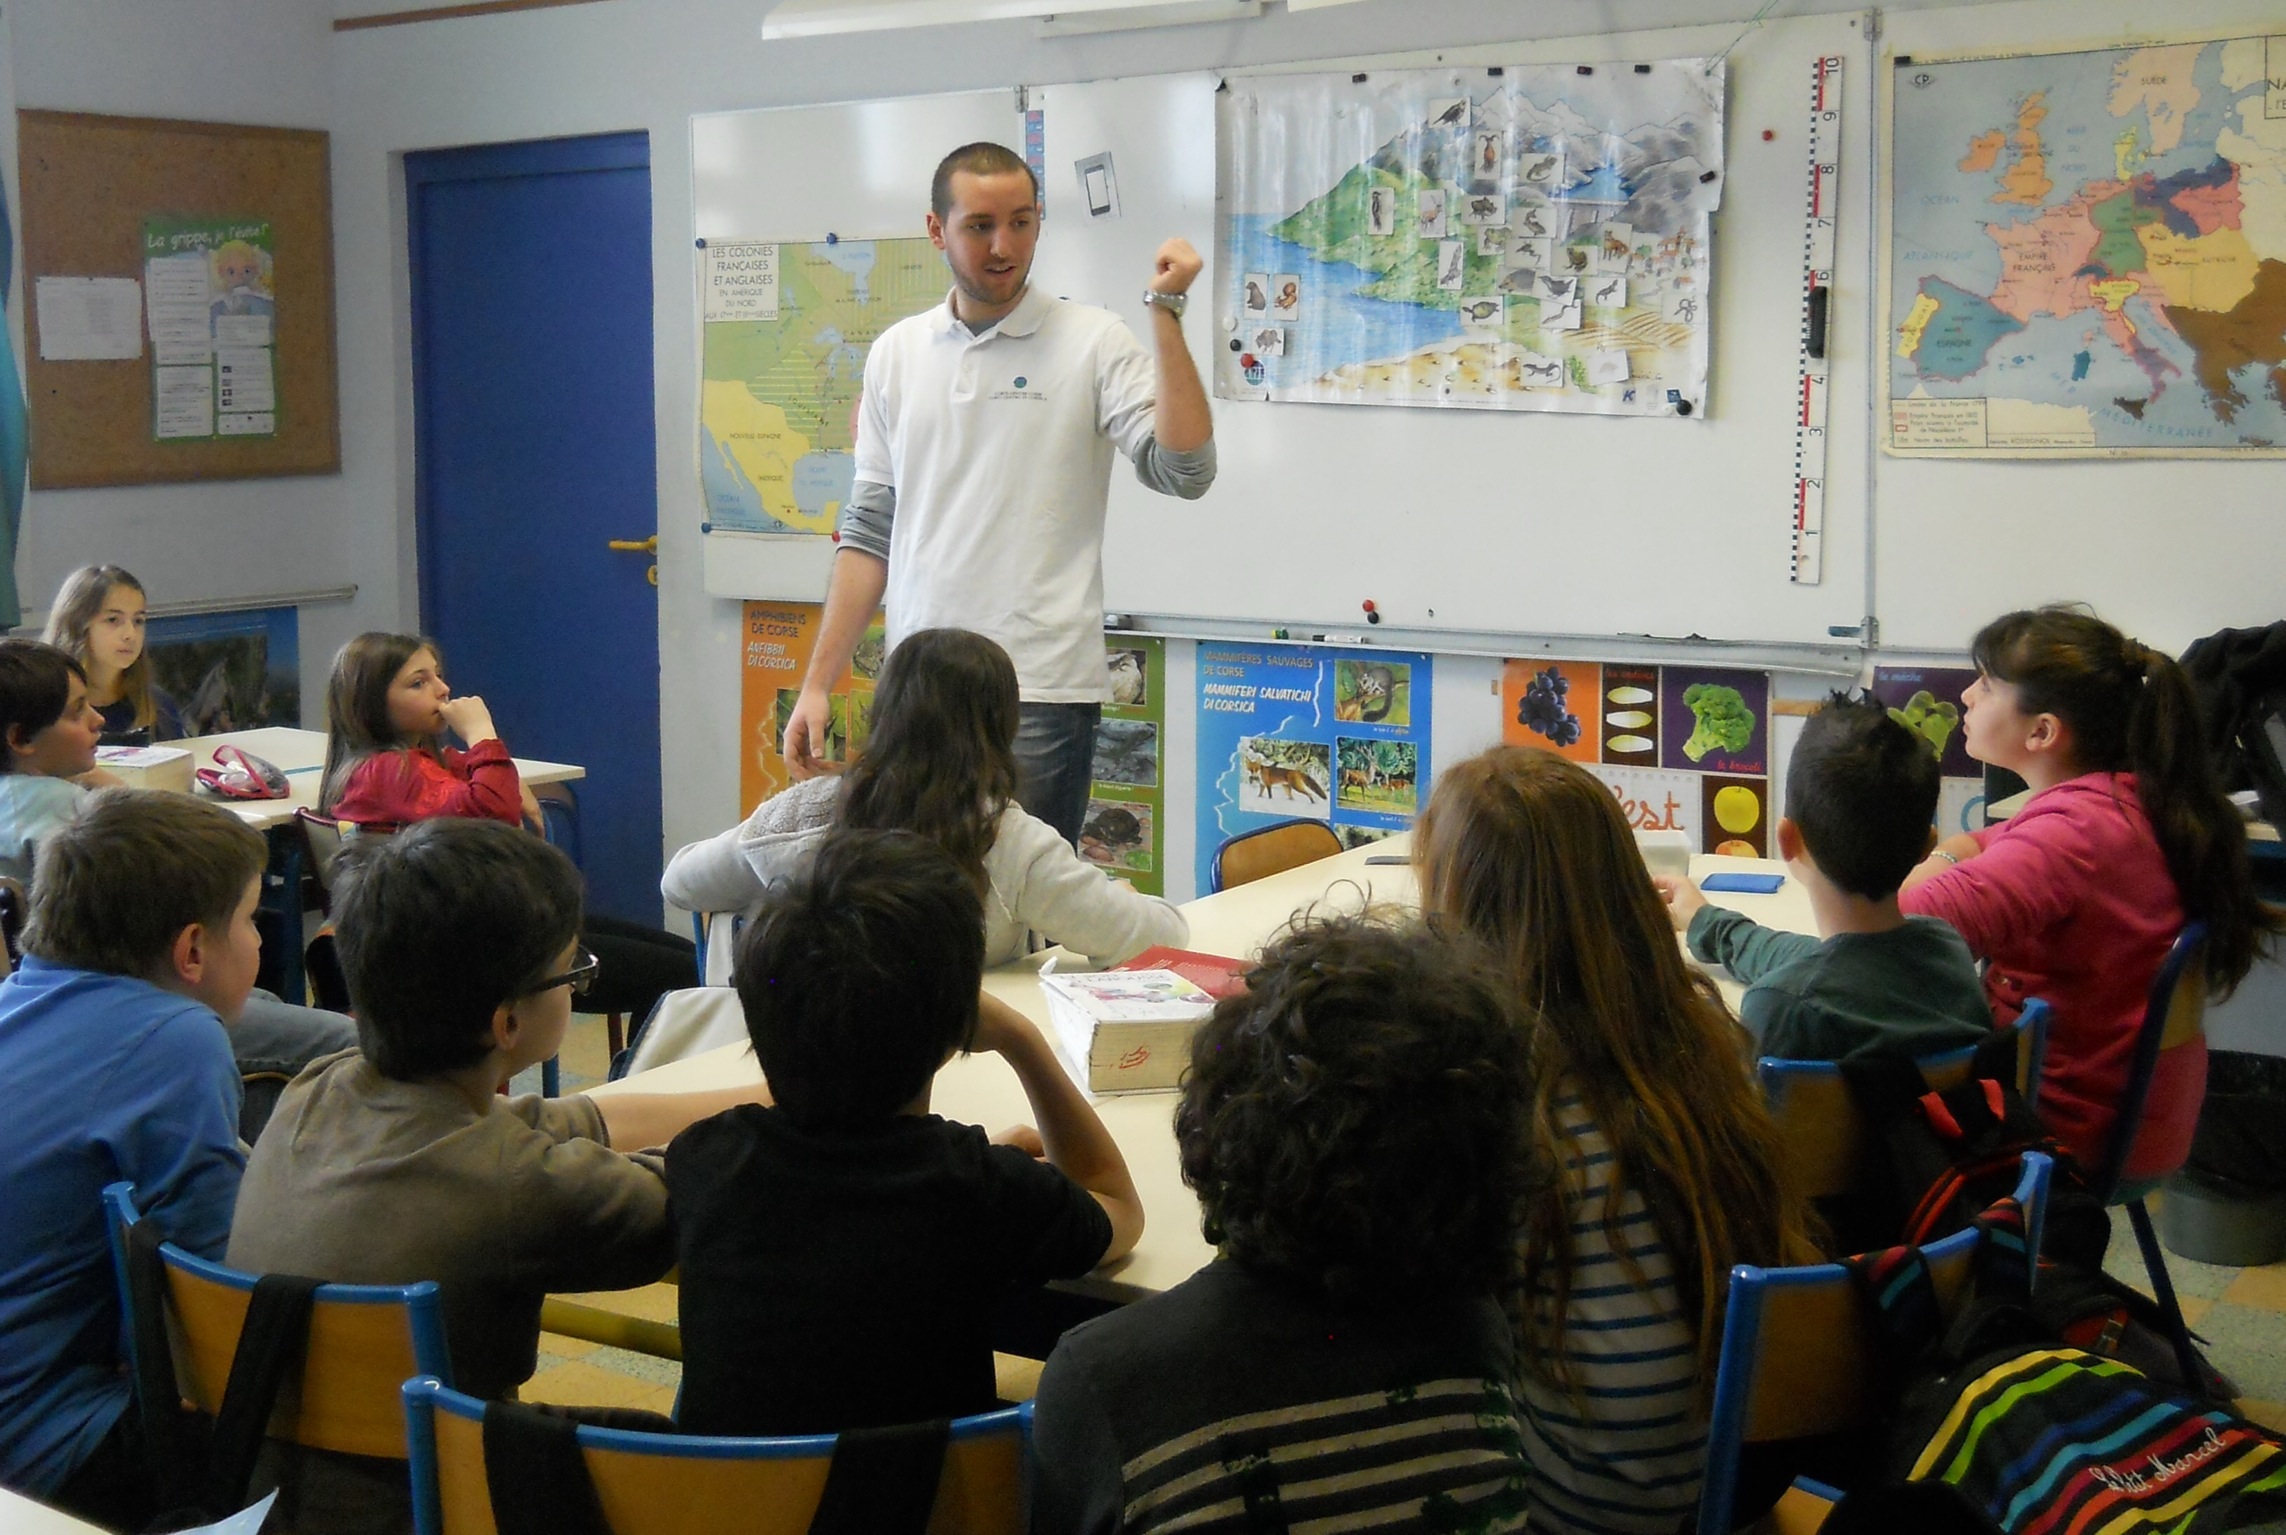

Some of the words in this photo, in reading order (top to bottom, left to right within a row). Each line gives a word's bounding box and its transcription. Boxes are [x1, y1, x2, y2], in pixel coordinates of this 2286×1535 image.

[1825, 57, 1839, 75] 10
[1822, 110, 1837, 122] 9
[1820, 164, 1835, 175] 8
[1817, 218, 1832, 228] 7
[712, 248, 726, 258] LES
[729, 246, 774, 258] COLONIES
[716, 260, 769, 271] FRANÇAISES
[714, 275, 723, 286] ET
[725, 274, 774, 286] ANGLAISES
[1815, 271, 1830, 281] 6
[1811, 375, 1824, 385] 4
[1809, 426, 1823, 436] 3
[1807, 479, 1821, 489] 2
[751, 622, 765, 634] DE
[758, 655, 797, 670] CORSICA
[1267, 654, 1314, 668] SAUVAGES
[1203, 665, 1215, 675] DE
[1217, 665, 1245, 677] CORSE
[1203, 683, 1257, 698] MAMMIFERI
[1259, 686, 1312, 702] SALVATICHI
[1203, 698, 1214, 710] DI
[1214, 699, 1255, 713] CORSICA
[2146, 1426, 2227, 1482] Marcel
